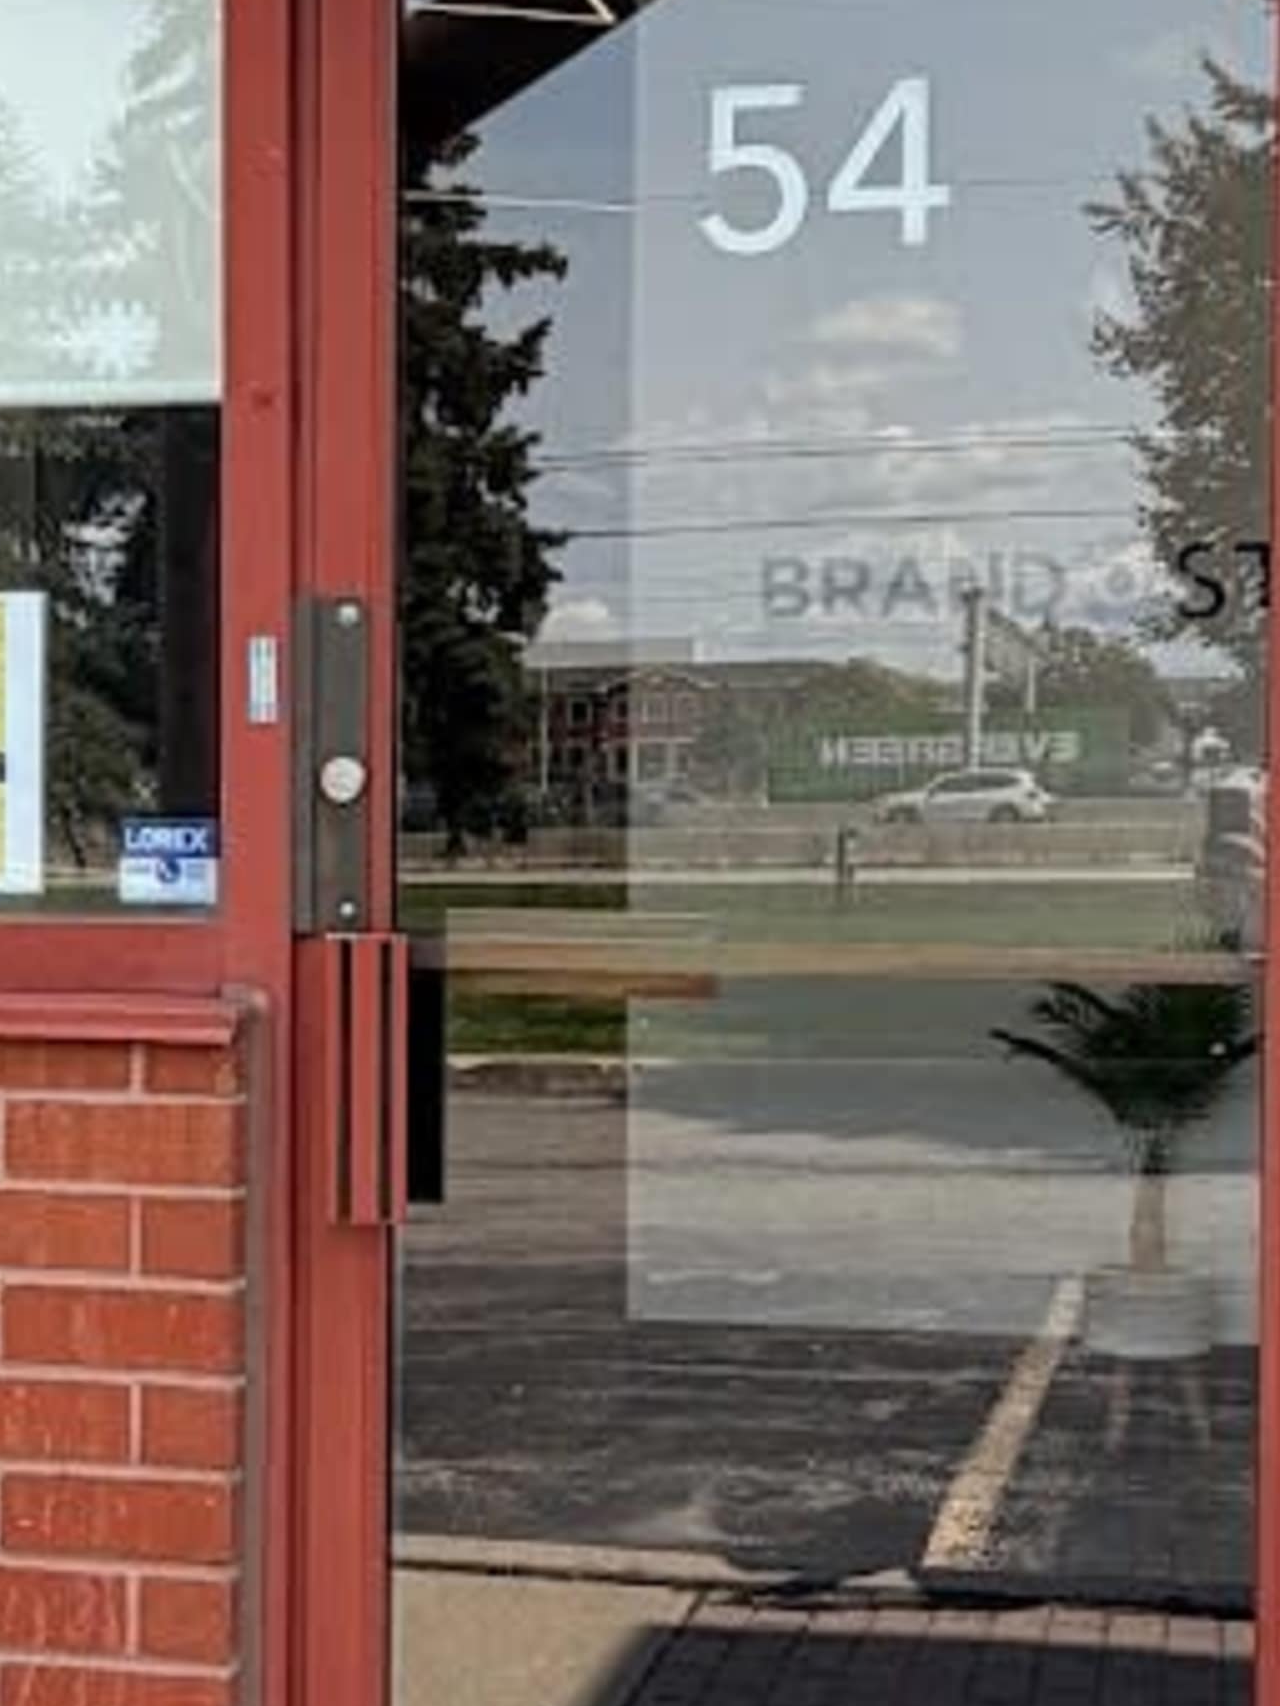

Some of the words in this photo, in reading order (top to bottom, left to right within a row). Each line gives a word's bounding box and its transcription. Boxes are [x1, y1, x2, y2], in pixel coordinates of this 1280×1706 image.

[697, 78, 951, 255] 54
[761, 552, 1066, 620] BRAND
[124, 825, 209, 853] LOREX
